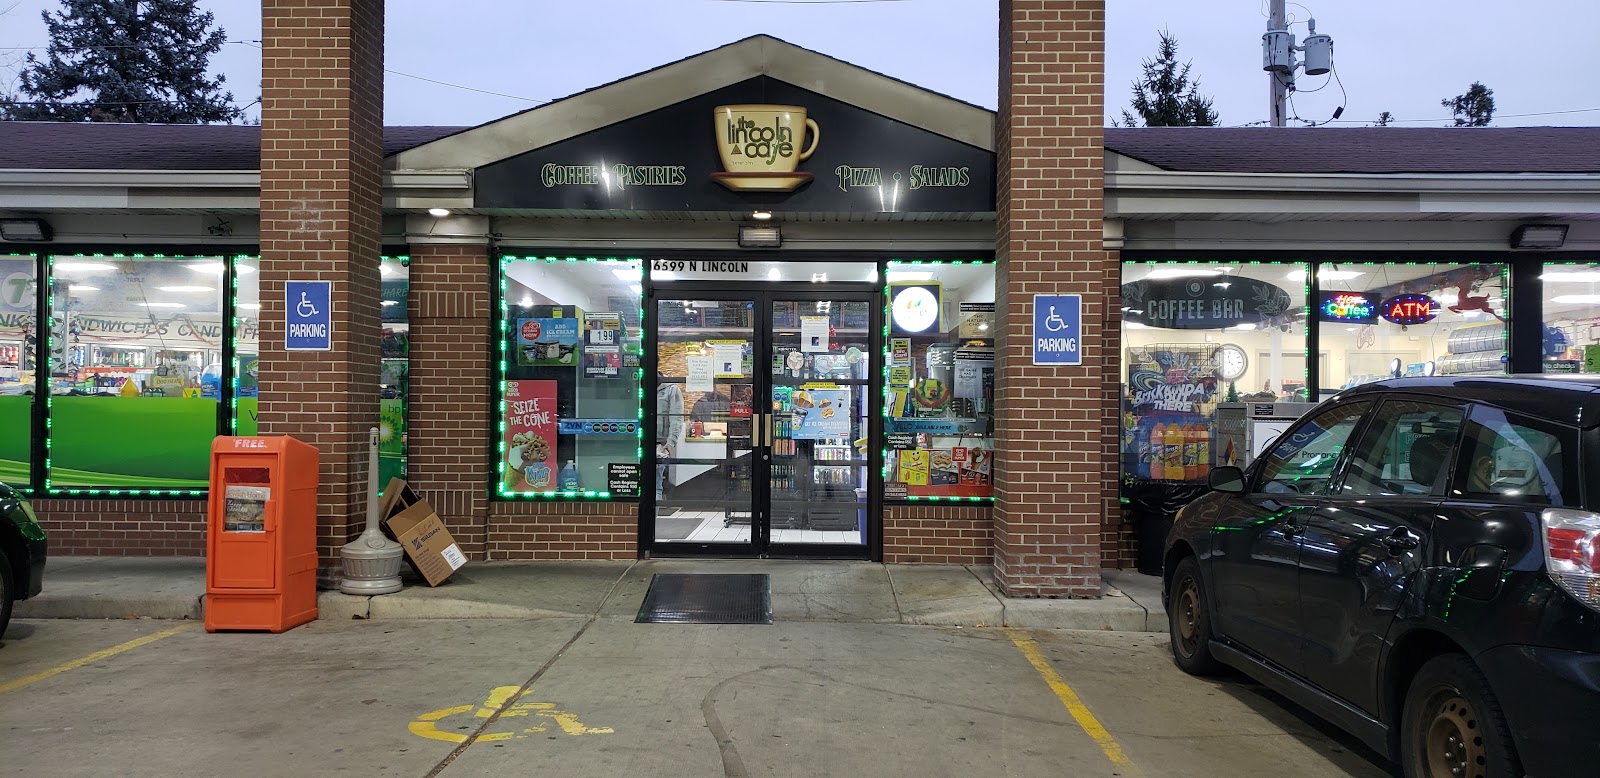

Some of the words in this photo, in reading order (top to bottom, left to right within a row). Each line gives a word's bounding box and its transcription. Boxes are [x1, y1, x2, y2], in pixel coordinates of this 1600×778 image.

[738, 116, 755, 128] the
[727, 117, 792, 144] lincoln
[541, 163, 598, 187] COFFEE
[613, 163, 687, 190] PASTRIES
[835, 165, 882, 192] PIZZA
[910, 164, 970, 190] SALADS
[653, 261, 685, 272] 6599
[689, 261, 697, 272] N
[702, 261, 748, 272] LINCOLN
[381, 288, 408, 298] HARE
[1147, 299, 1205, 320] COFFEE
[1212, 299, 1244, 319] BAR
[1391, 301, 1430, 317] ATM
[178, 322, 223, 338] CAND
[290, 323, 326, 338] PARKING
[597, 331, 613, 341] 1.99
[1038, 337, 1076, 352] PARKING
[388, 404, 401, 414] bp
[513, 398, 540, 415] SEIZE
[1154, 400, 1192, 412] THERE
[509, 416, 522, 426] THE
[523, 411, 551, 427] CONE
